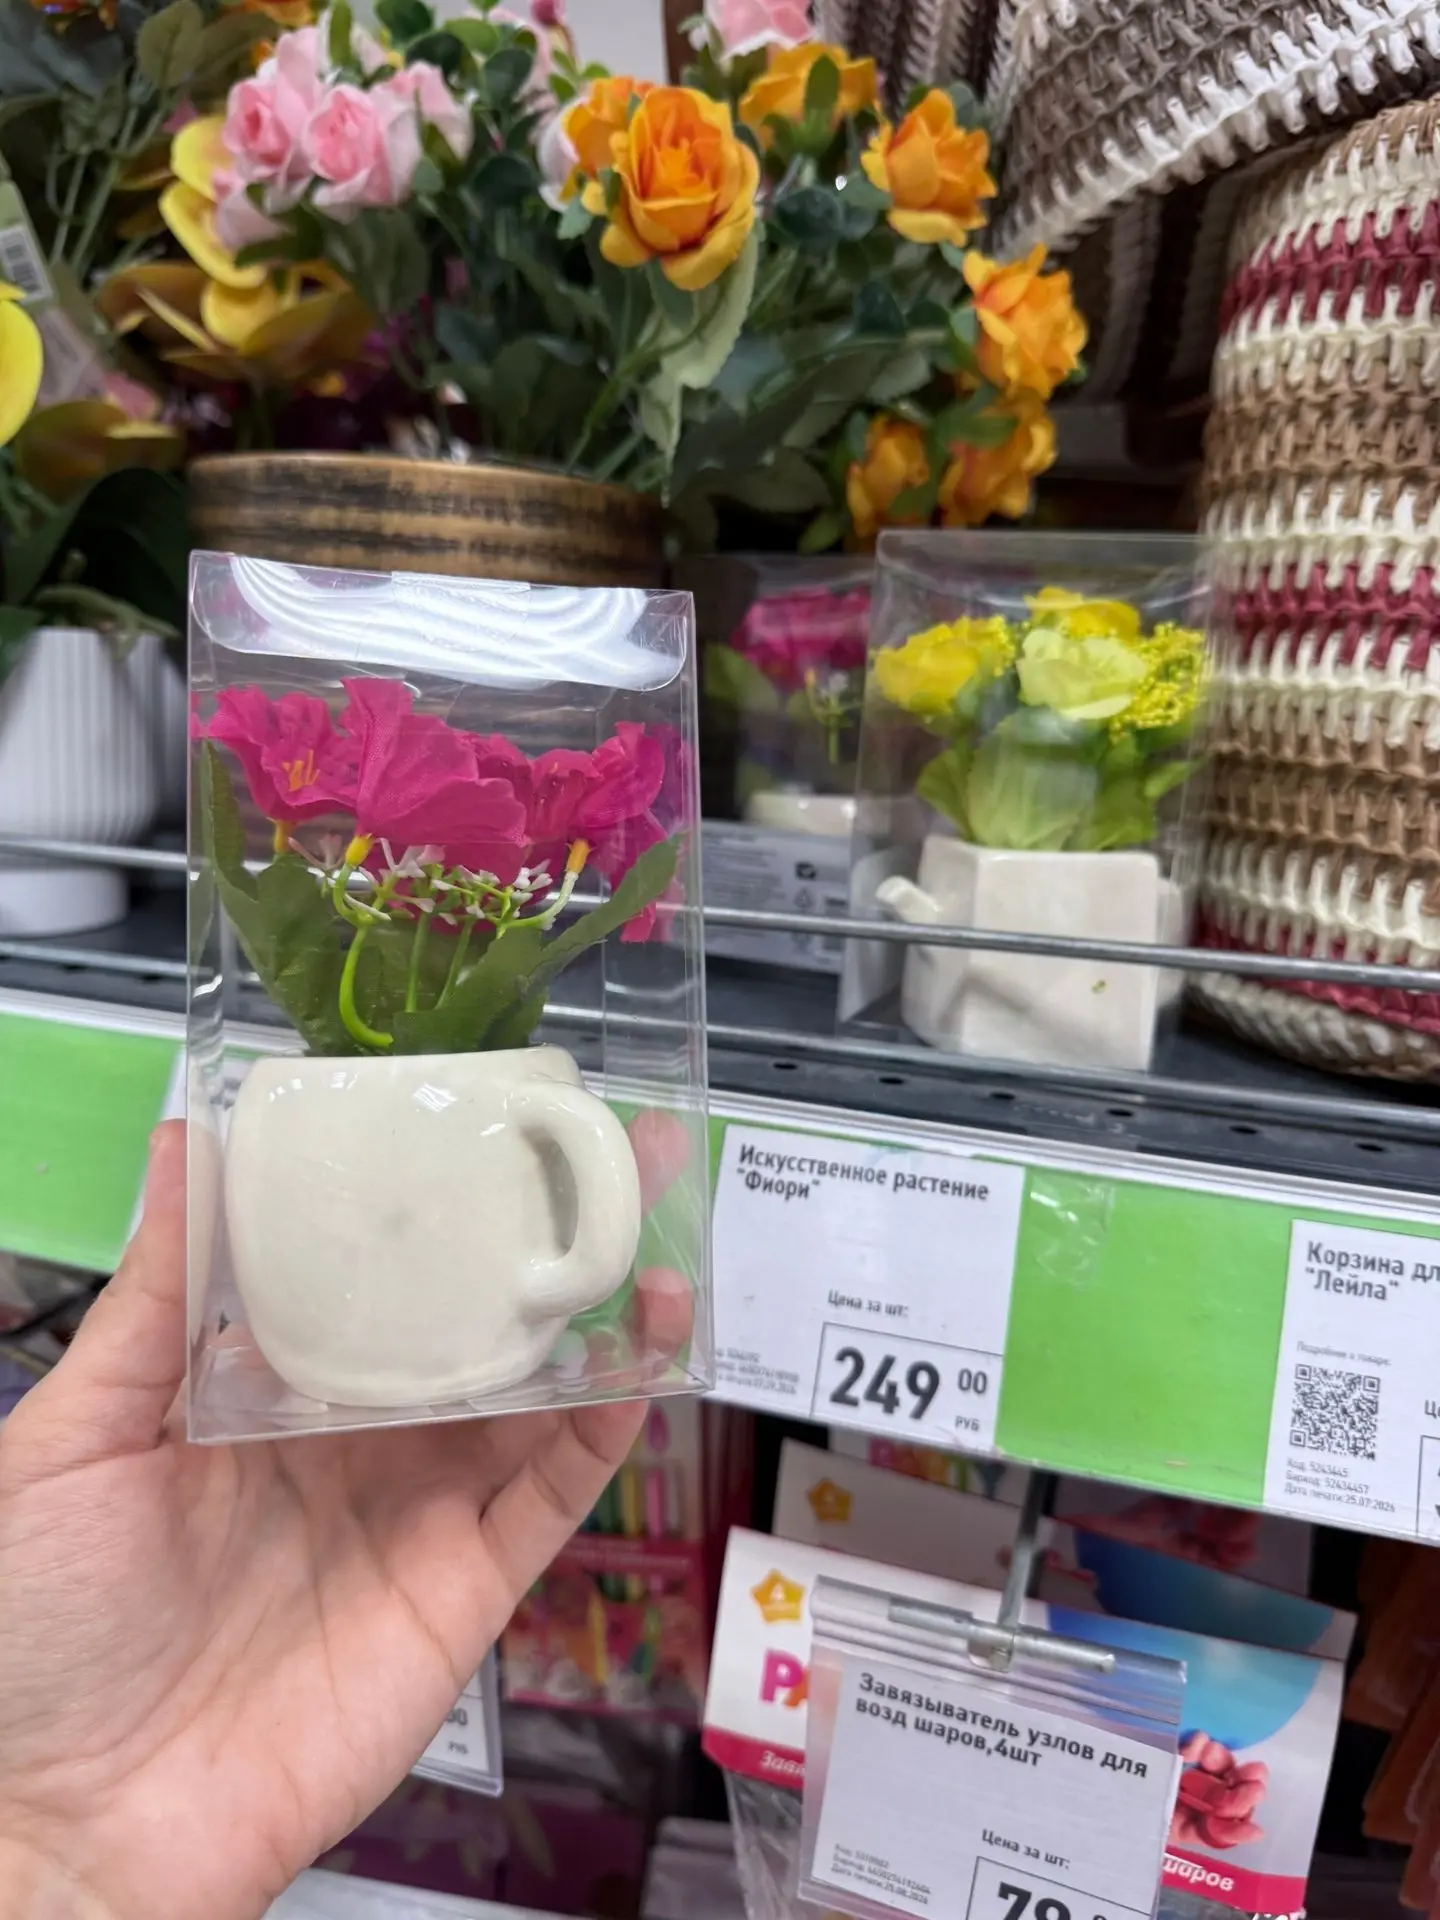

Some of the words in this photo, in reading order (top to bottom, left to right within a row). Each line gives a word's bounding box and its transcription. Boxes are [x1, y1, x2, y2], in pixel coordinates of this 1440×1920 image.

[736, 1166, 821, 1201] "Фиори"
[738, 1143, 888, 1185] Искусственное
[892, 1170, 990, 1200] растение
[1306, 1240, 1405, 1275] Корзина
[1305, 1266, 1399, 1301] "Лейла"
[828, 1289, 863, 1309] Цена
[866, 1299, 881, 1313] за
[884, 1303, 909, 1318] шт:
[829, 1346, 941, 1420] 249
[957, 1368, 988, 1394] 00
[954, 1415, 980, 1431] РУБ
[1309, 1461, 1348, 1478] 5243445
[1324, 1476, 1369, 1495] 52434457
[855, 1697, 908, 1729] возд
[913, 1713, 1042, 1767] шаров,4шт
[859, 1671, 1021, 1738] Завязыватель
[1027, 1726, 1095, 1761] узлов
[1100, 1750, 1149, 1778] для
[981, 1828, 1020, 1852] Цена
[1023, 1845, 1041, 1859] за
[1044, 1852, 1071, 1869] шт:
